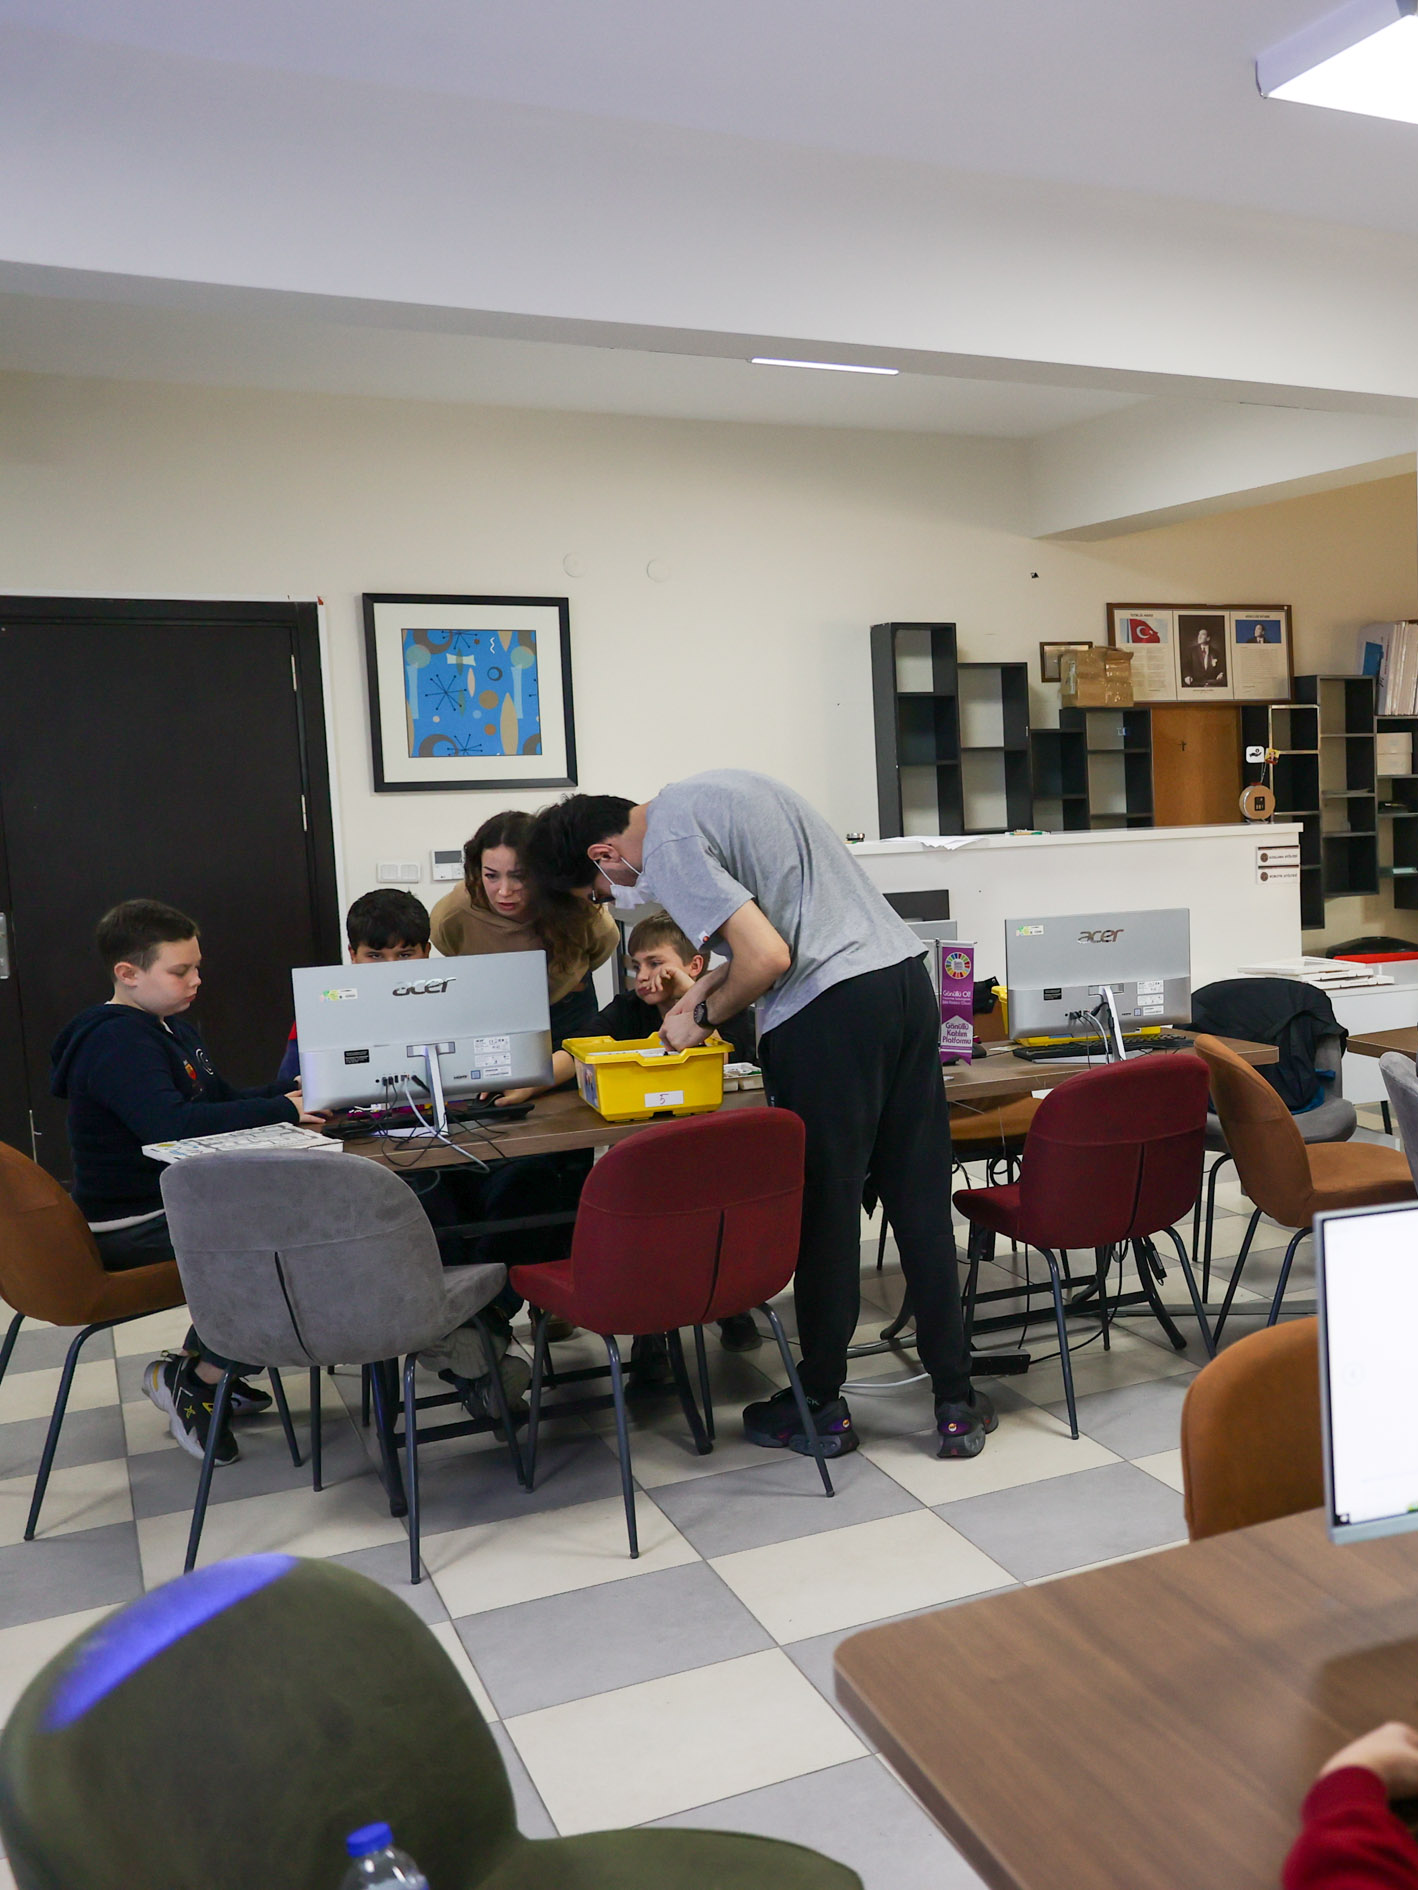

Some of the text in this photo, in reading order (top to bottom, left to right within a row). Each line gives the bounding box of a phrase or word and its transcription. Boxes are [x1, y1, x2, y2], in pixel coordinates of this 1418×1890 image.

[1077, 929, 1125, 944] acer
[392, 976, 457, 997] acer
[659, 1093, 669, 1105] 5
